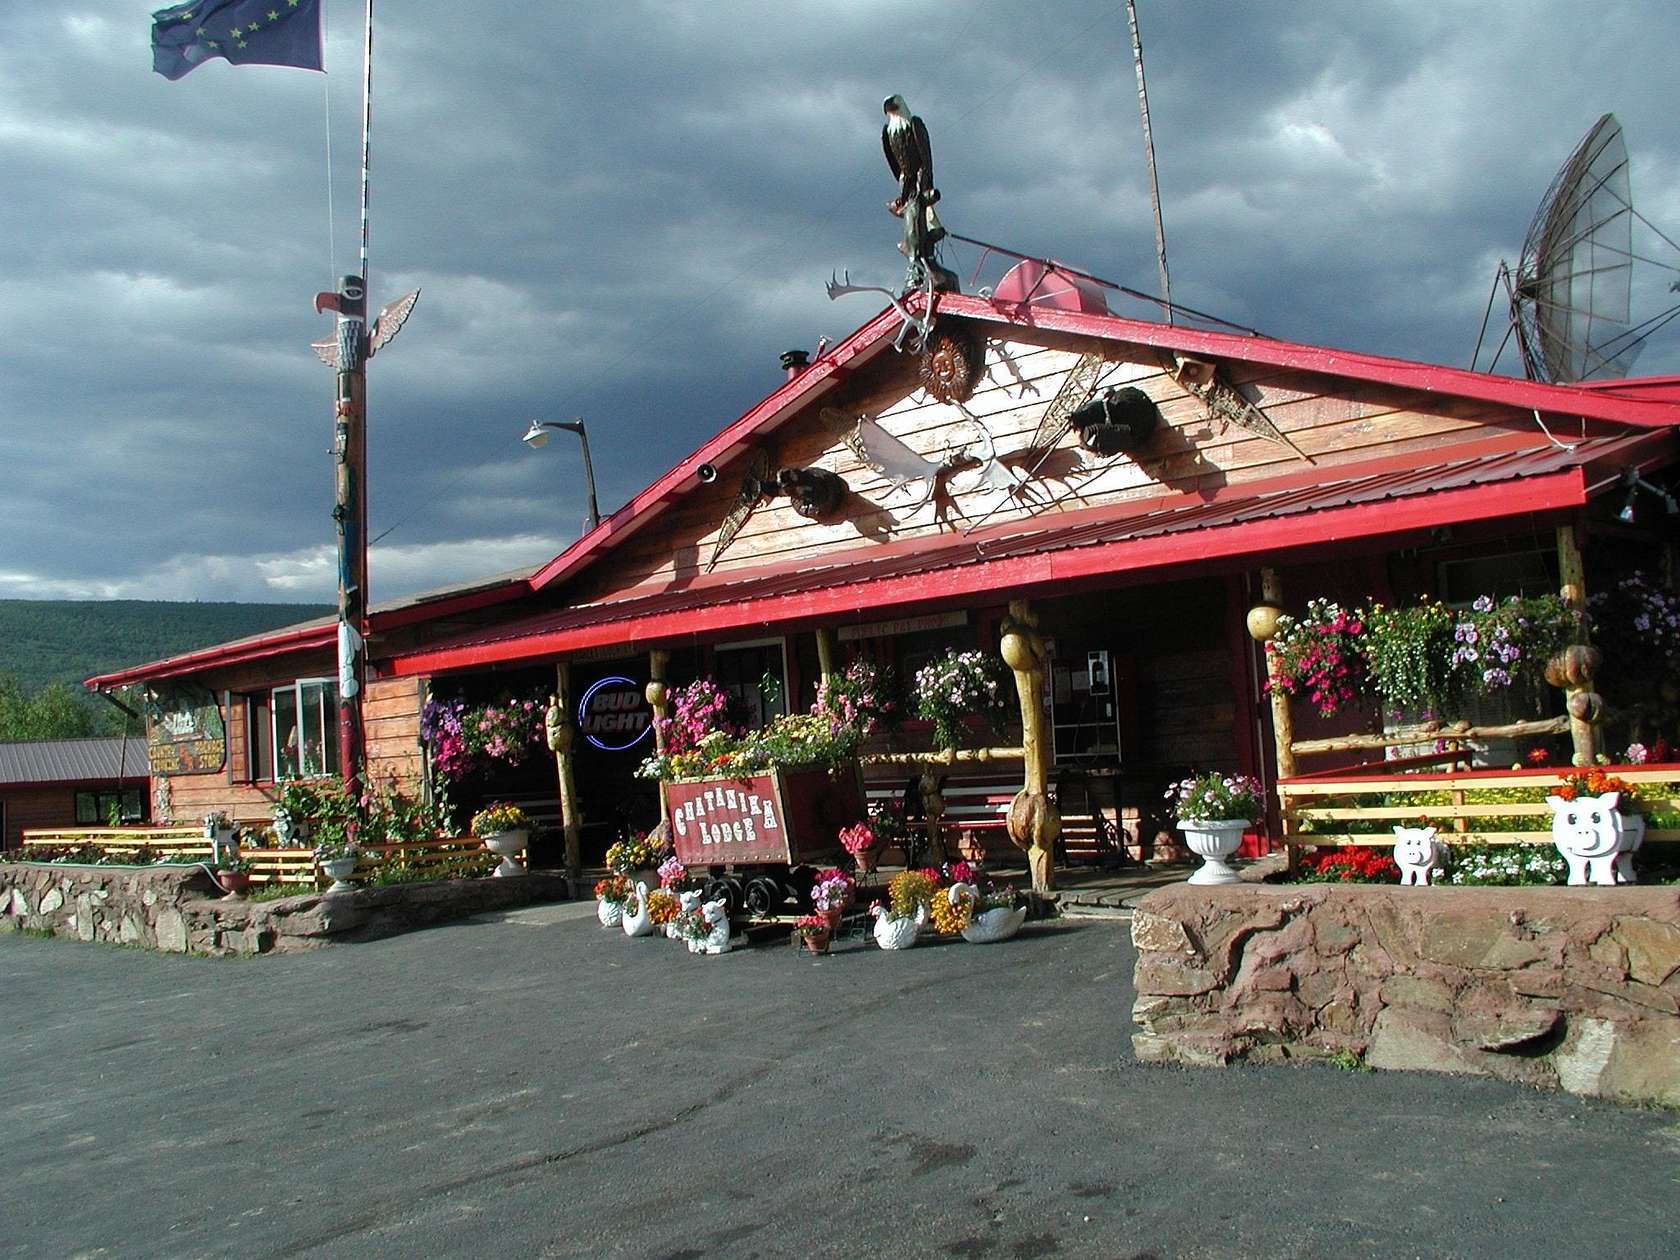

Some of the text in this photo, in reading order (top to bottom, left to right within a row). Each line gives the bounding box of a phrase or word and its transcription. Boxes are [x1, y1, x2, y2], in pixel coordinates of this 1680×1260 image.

[592, 691, 641, 712] BUD
[583, 711, 649, 733] LIGHT
[674, 787, 778, 836] CHATANIKA
[699, 817, 757, 845] LODGE
